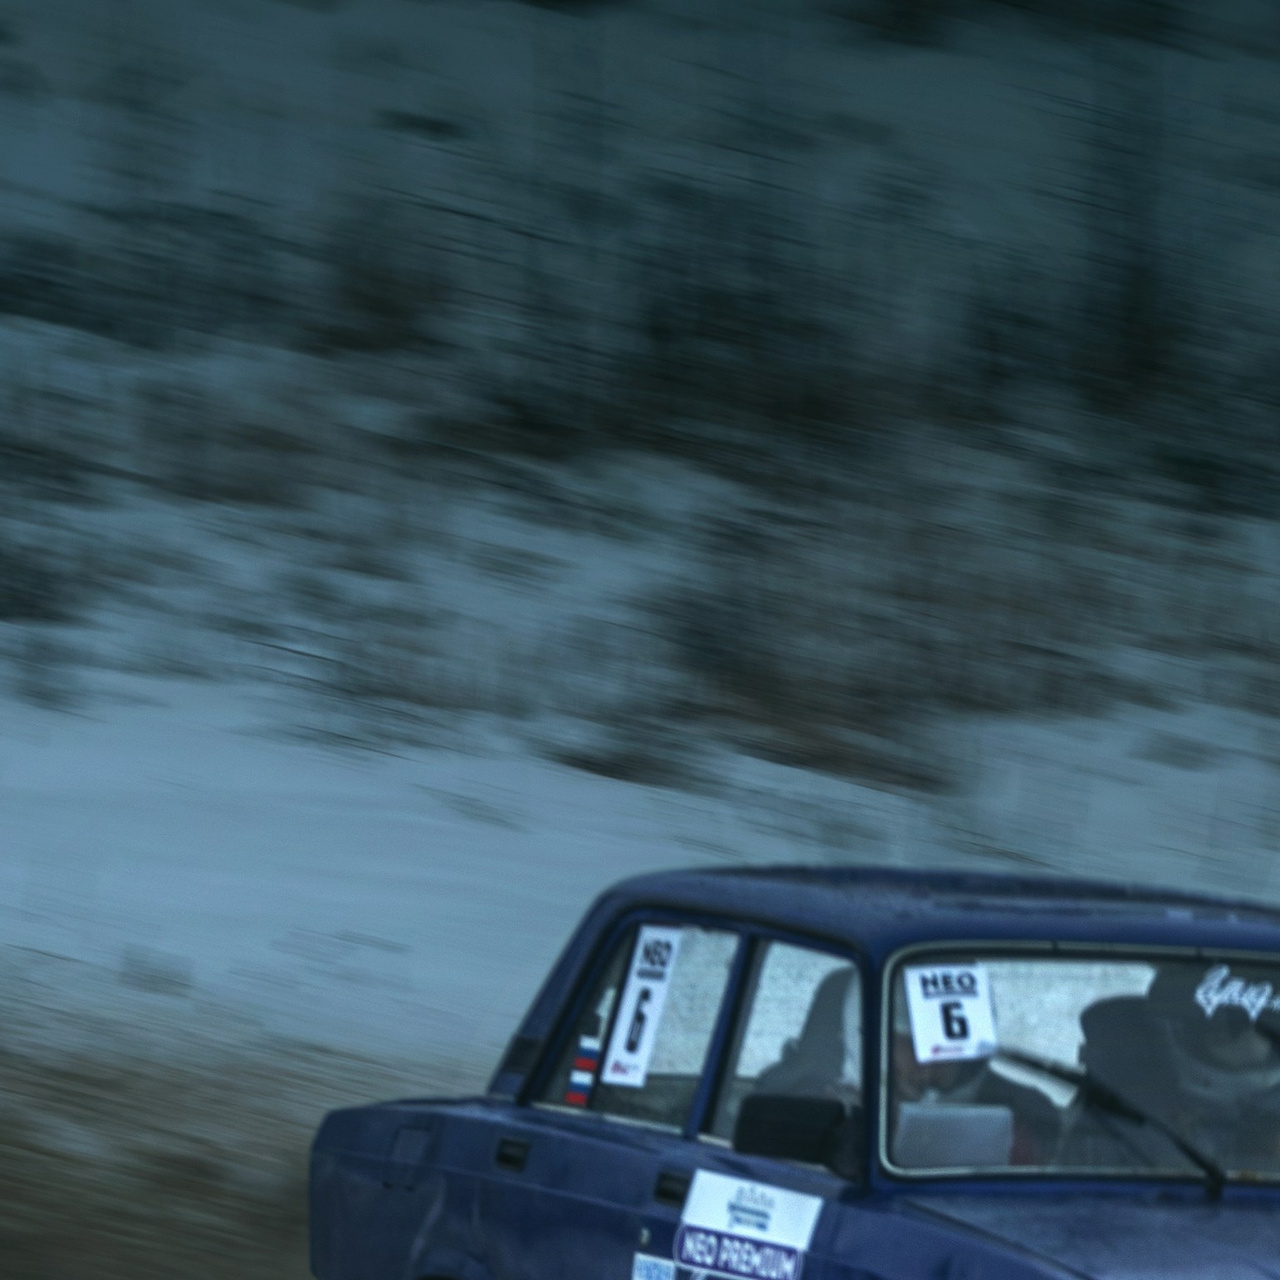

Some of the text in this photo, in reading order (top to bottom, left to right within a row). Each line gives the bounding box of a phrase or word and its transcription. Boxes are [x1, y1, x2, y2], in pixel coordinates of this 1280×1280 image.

[920, 971, 979, 994] NEO
[940, 1001, 970, 1040] 6
[681, 1230, 719, 1266] NEO
